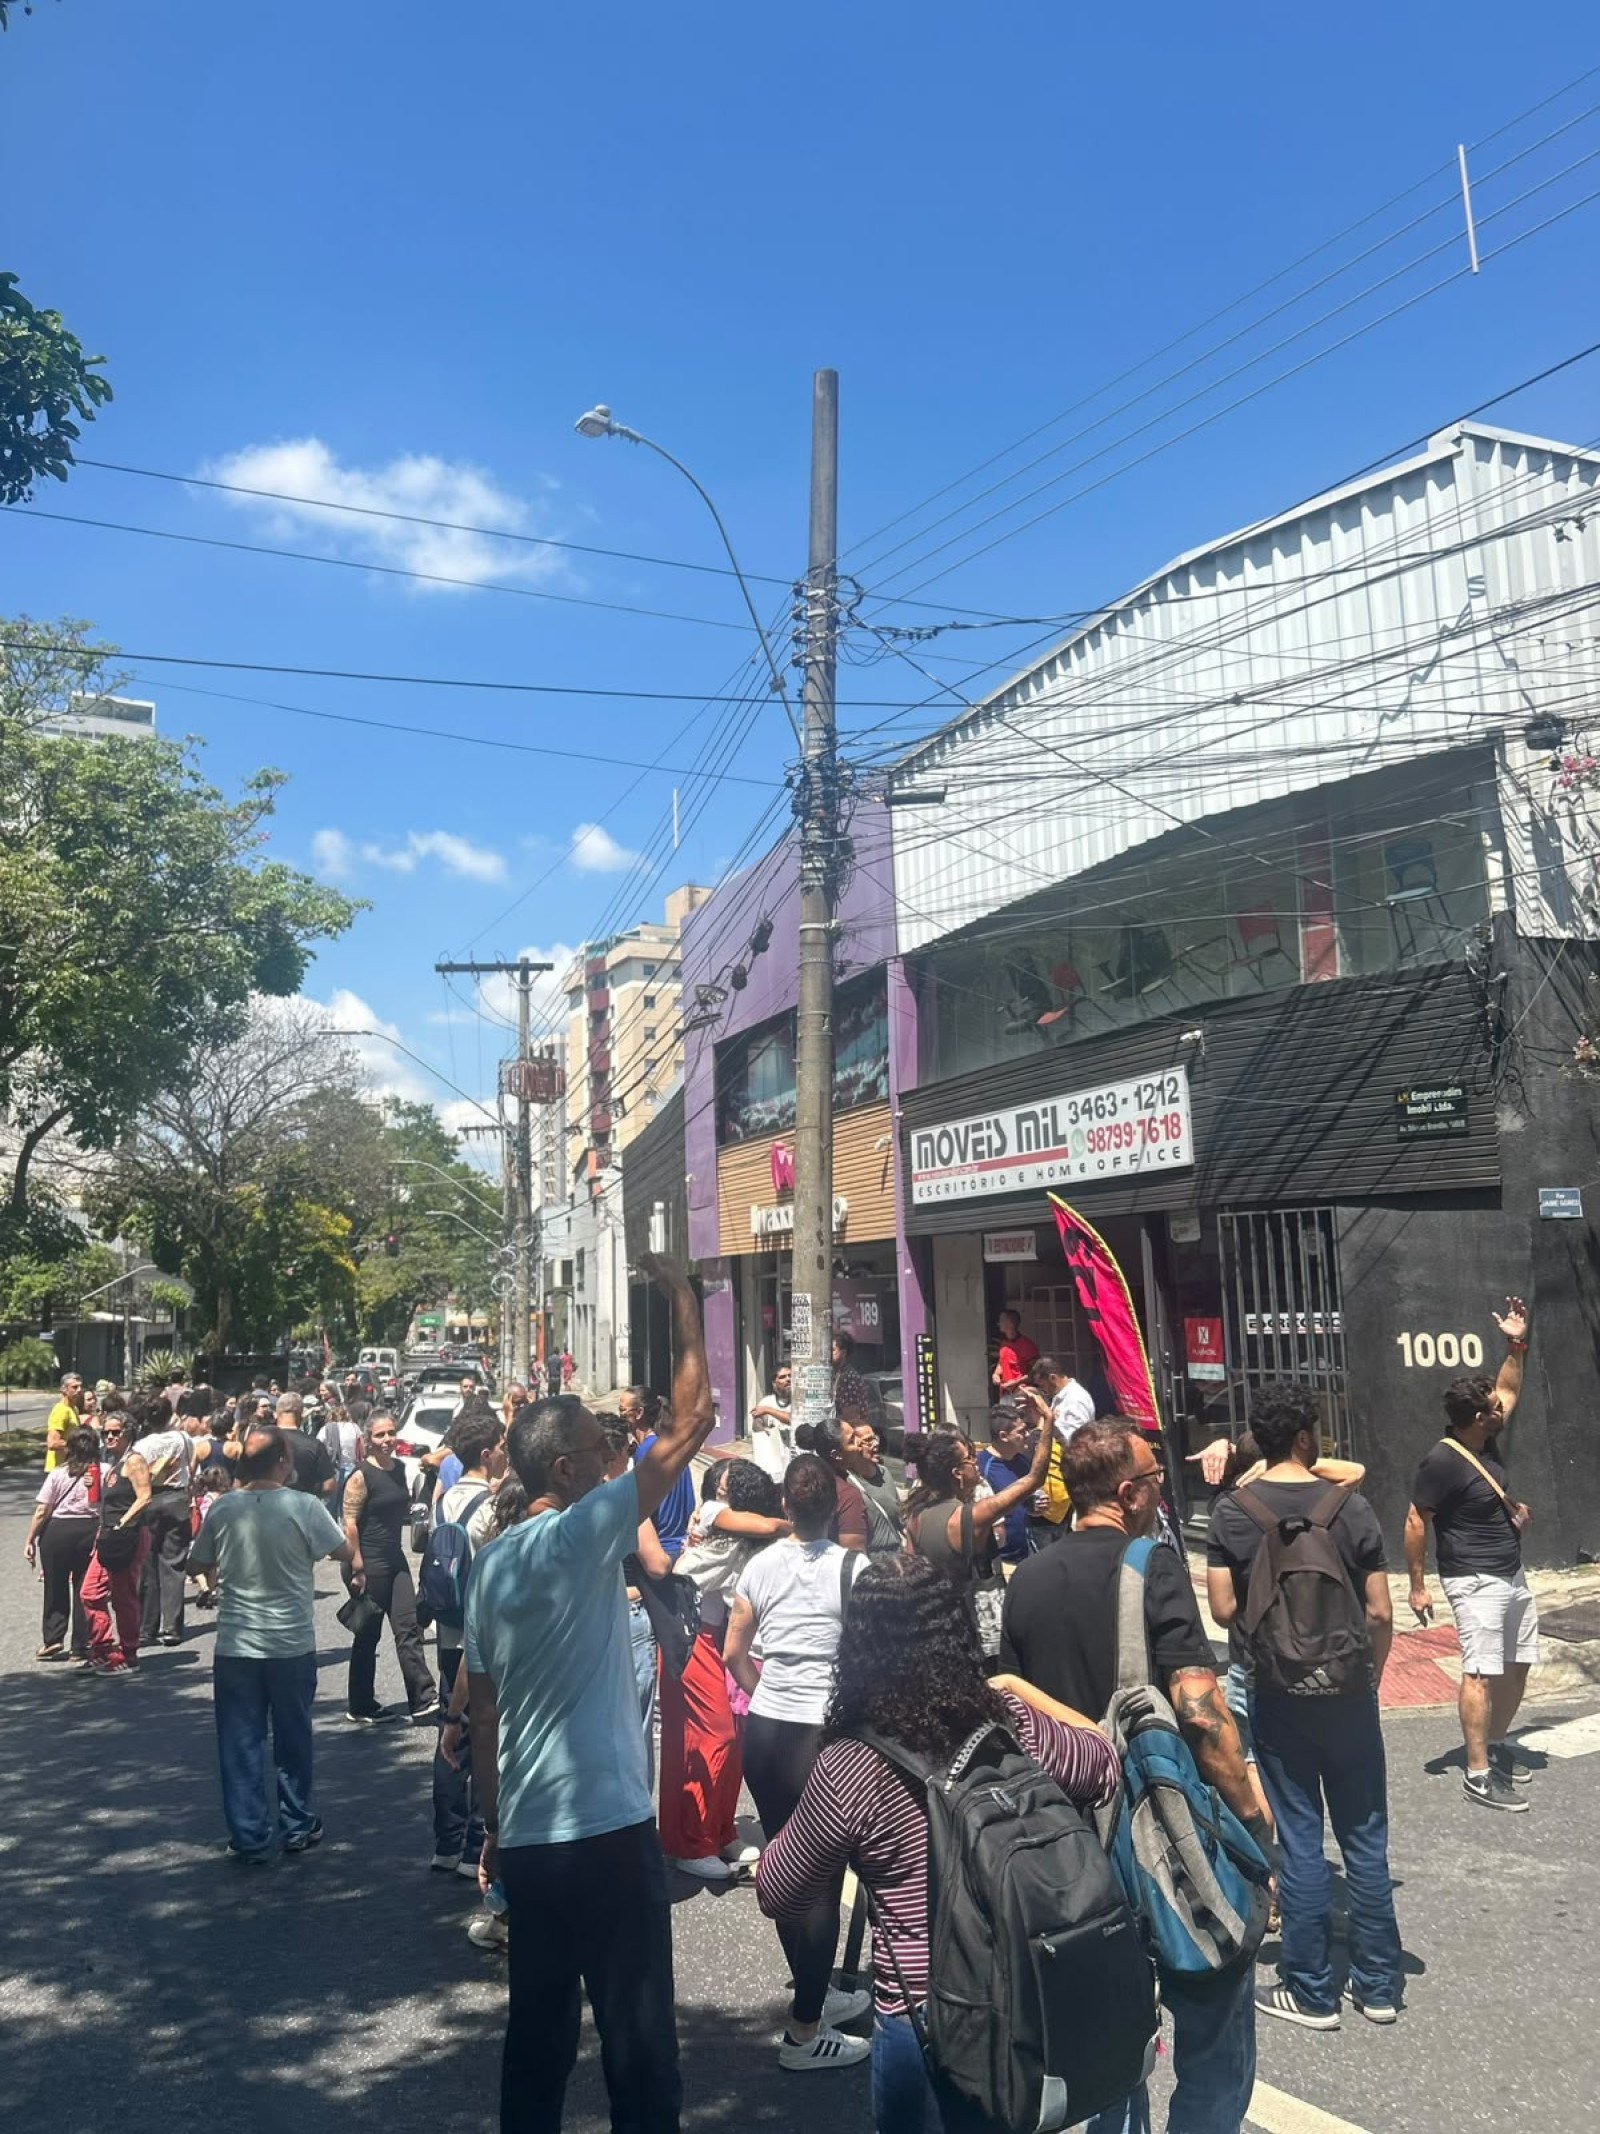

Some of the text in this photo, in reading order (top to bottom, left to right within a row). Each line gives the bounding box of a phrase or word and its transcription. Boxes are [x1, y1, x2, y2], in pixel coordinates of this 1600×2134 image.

[918, 1146, 1181, 1198] ESCRITÓRIO E HOME OFFICE
[1397, 1331, 1484, 1367] 1000
[1287, 1686, 1342, 1696] adidas
